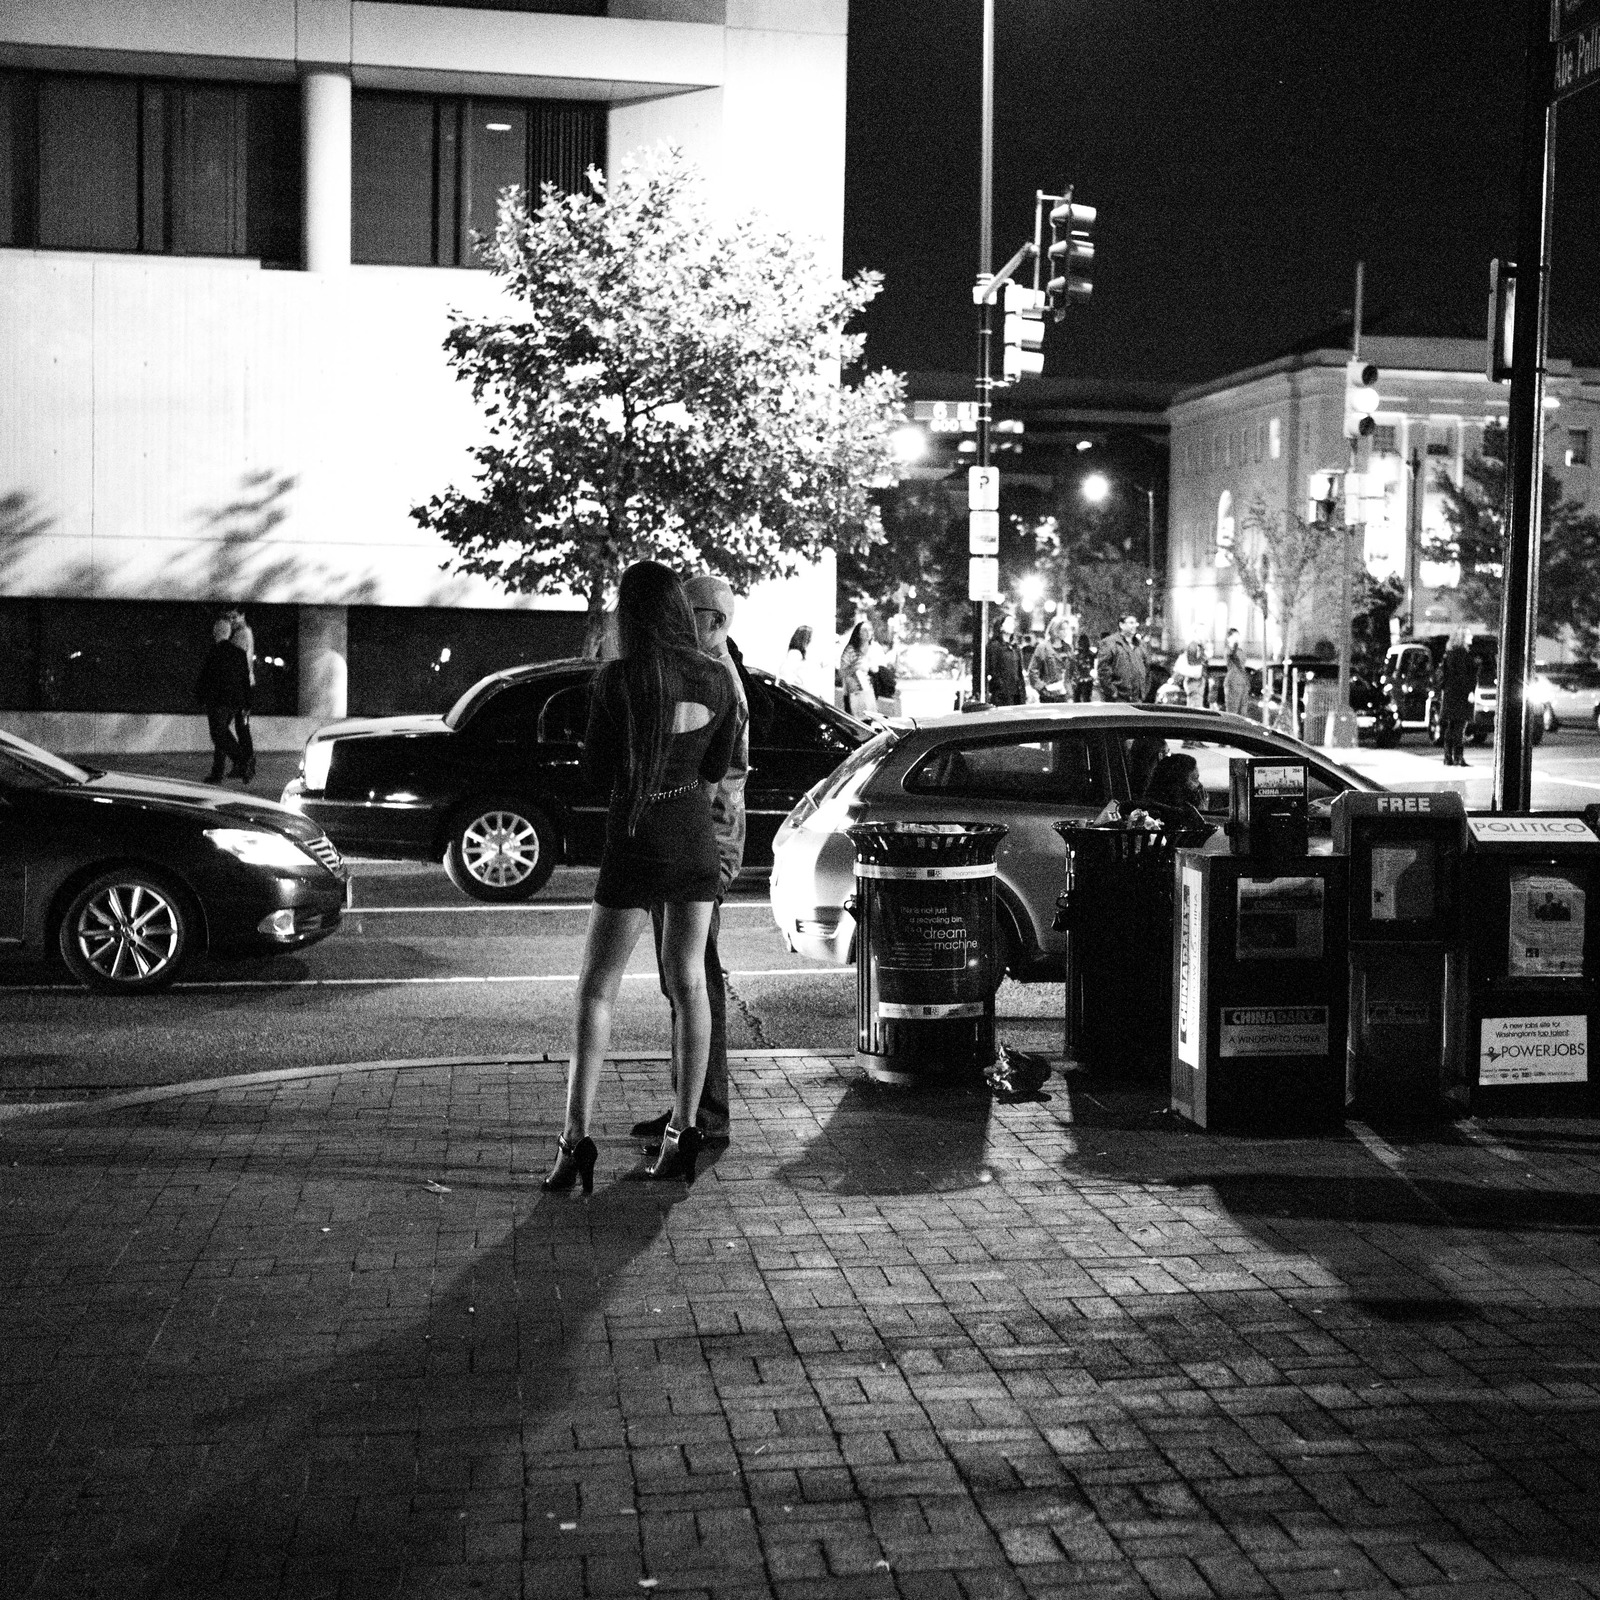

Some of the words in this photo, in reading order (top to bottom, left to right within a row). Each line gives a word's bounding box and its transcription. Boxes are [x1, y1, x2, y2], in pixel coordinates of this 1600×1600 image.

[1377, 797, 1431, 812] FREE
[1473, 822, 1587, 833] POLITICO
[934, 906, 948, 916] just
[923, 926, 967, 939] dream
[934, 940, 977, 950] machine
[1238, 1035, 1277, 1043] WINDOW
[1495, 1030, 1537, 1039] Washington's
[1501, 1042, 1586, 1058] POWERJOBS
